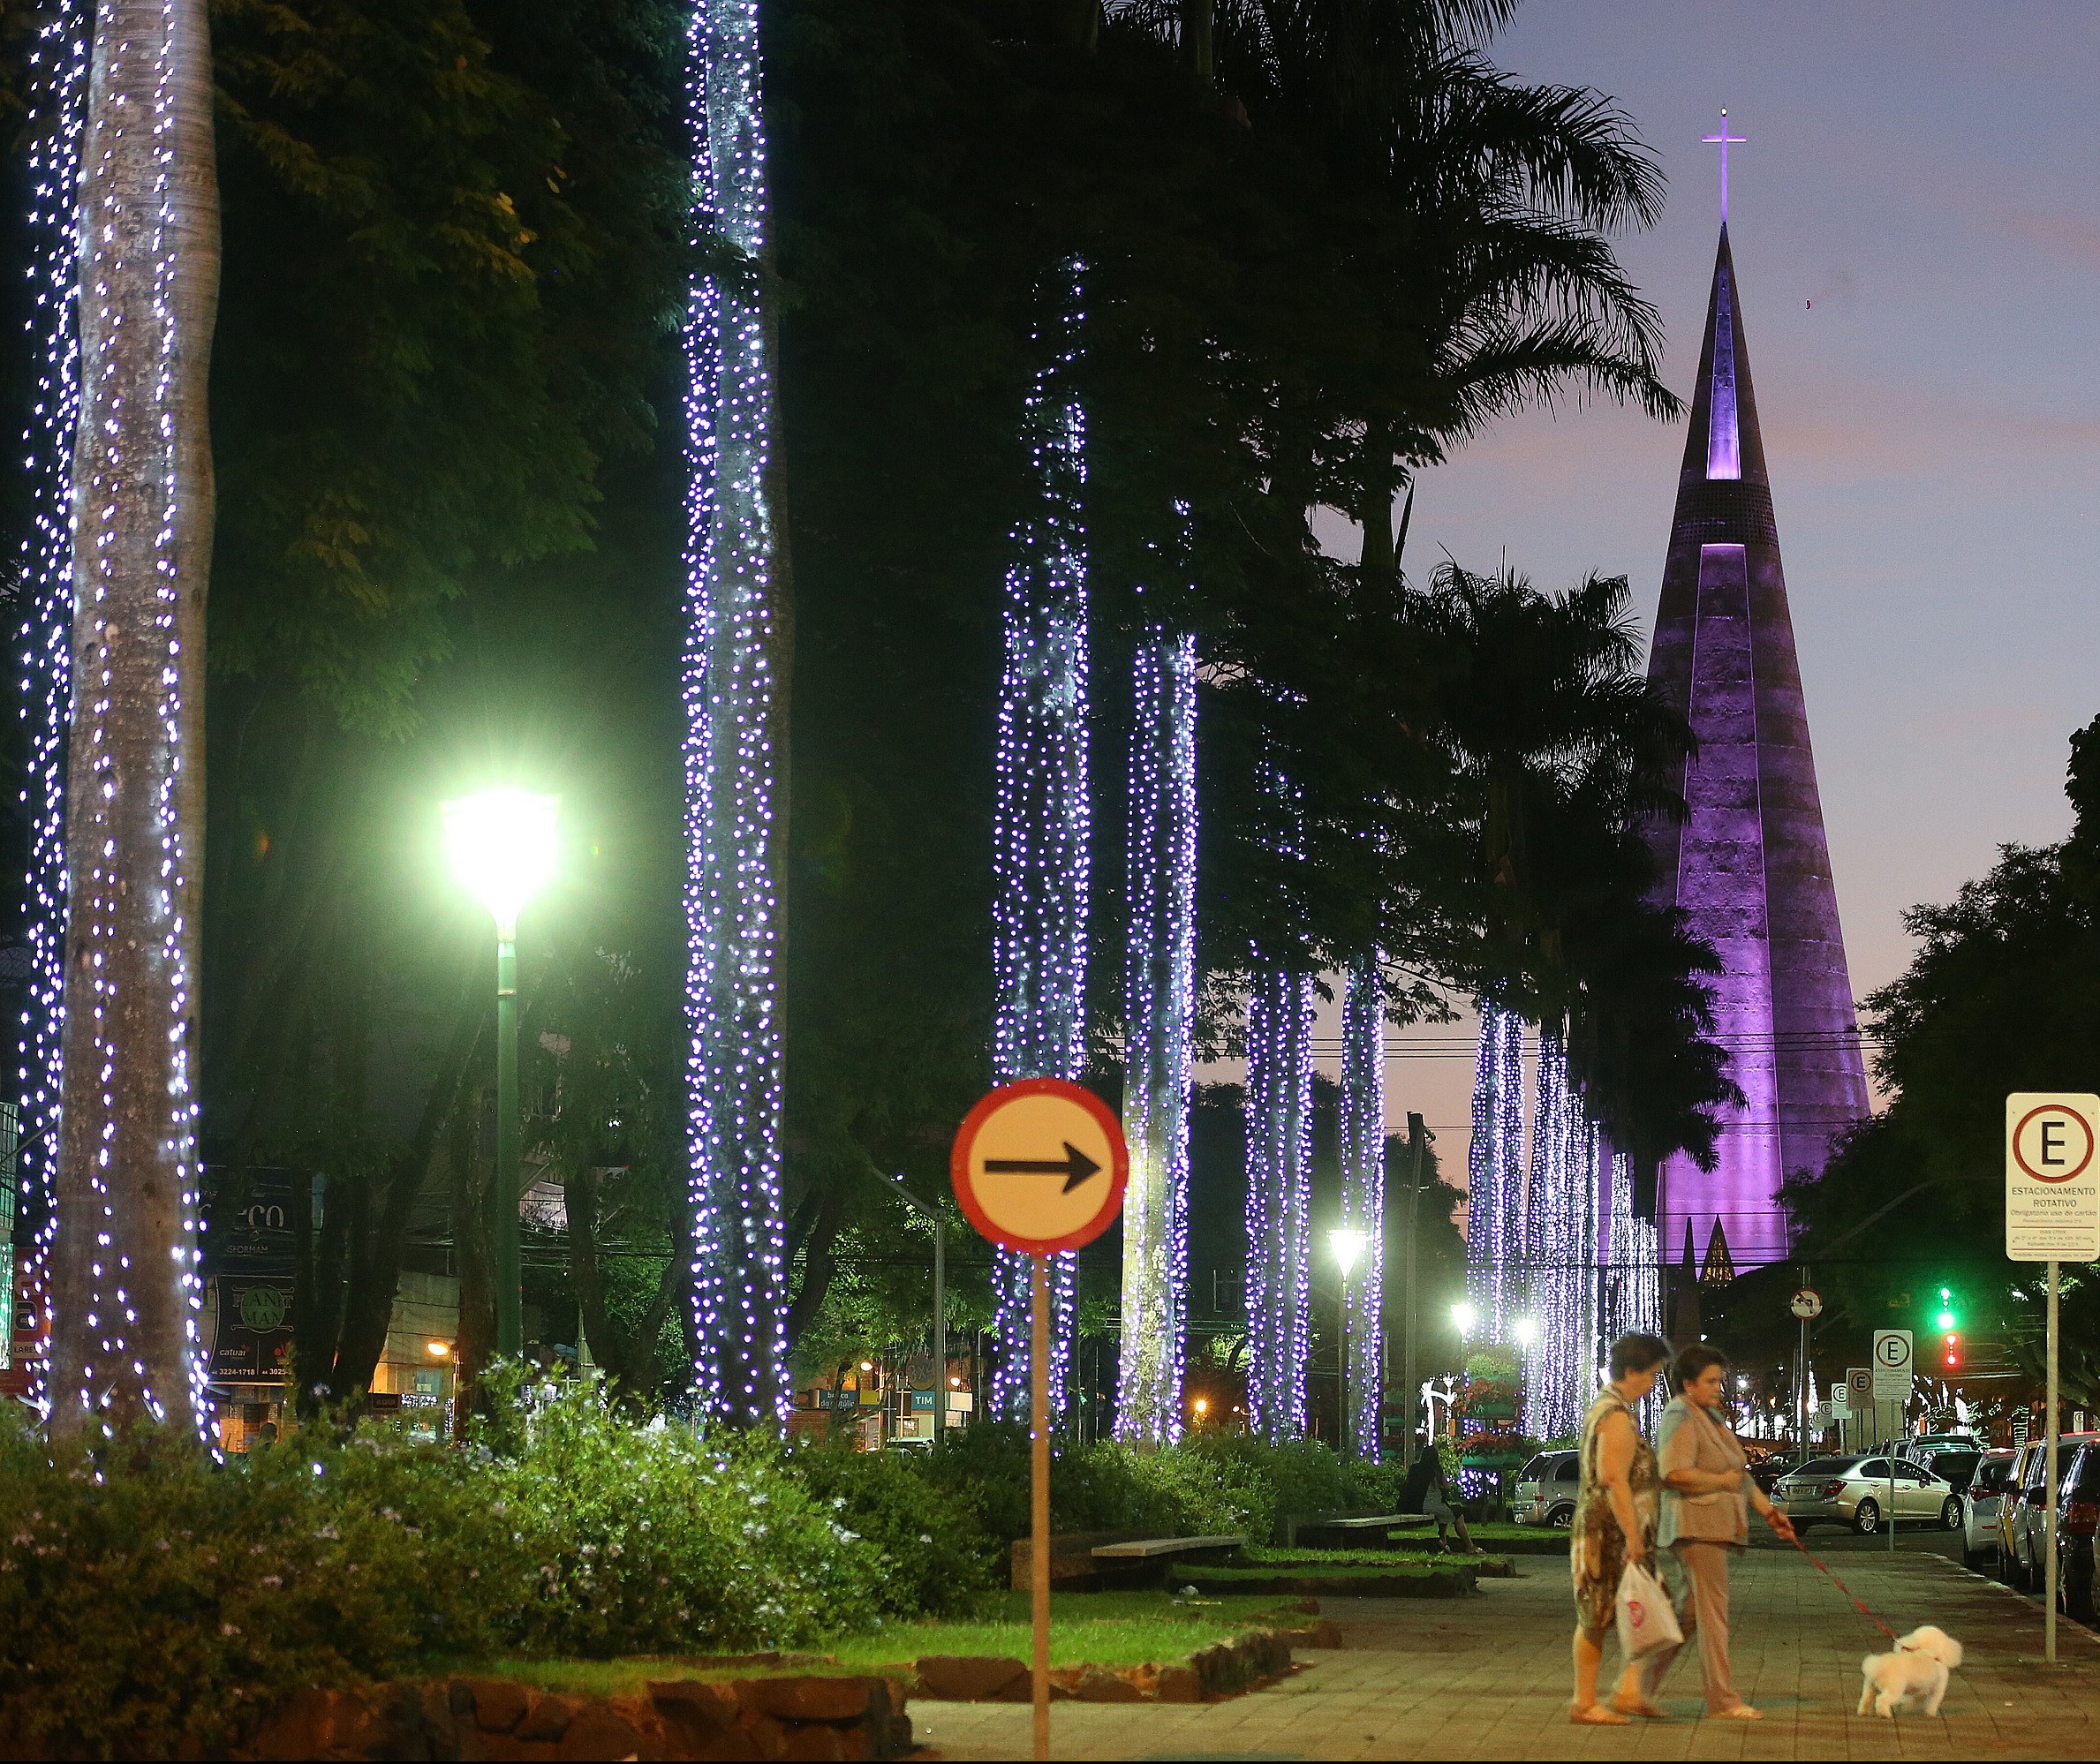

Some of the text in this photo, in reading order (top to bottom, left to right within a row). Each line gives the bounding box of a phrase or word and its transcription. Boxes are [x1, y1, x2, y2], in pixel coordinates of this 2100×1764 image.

[2042, 1121, 2065, 1165] E
[2012, 1187, 2096, 1195] ESTACIONAMENTO
[2033, 1199, 2077, 1208] ROTATIVO
[1887, 1341, 1899, 1361] E
[1856, 1376, 1866, 1388] E
[1838, 1389, 1845, 1398] E
[916, 1396, 933, 1405] TIM
